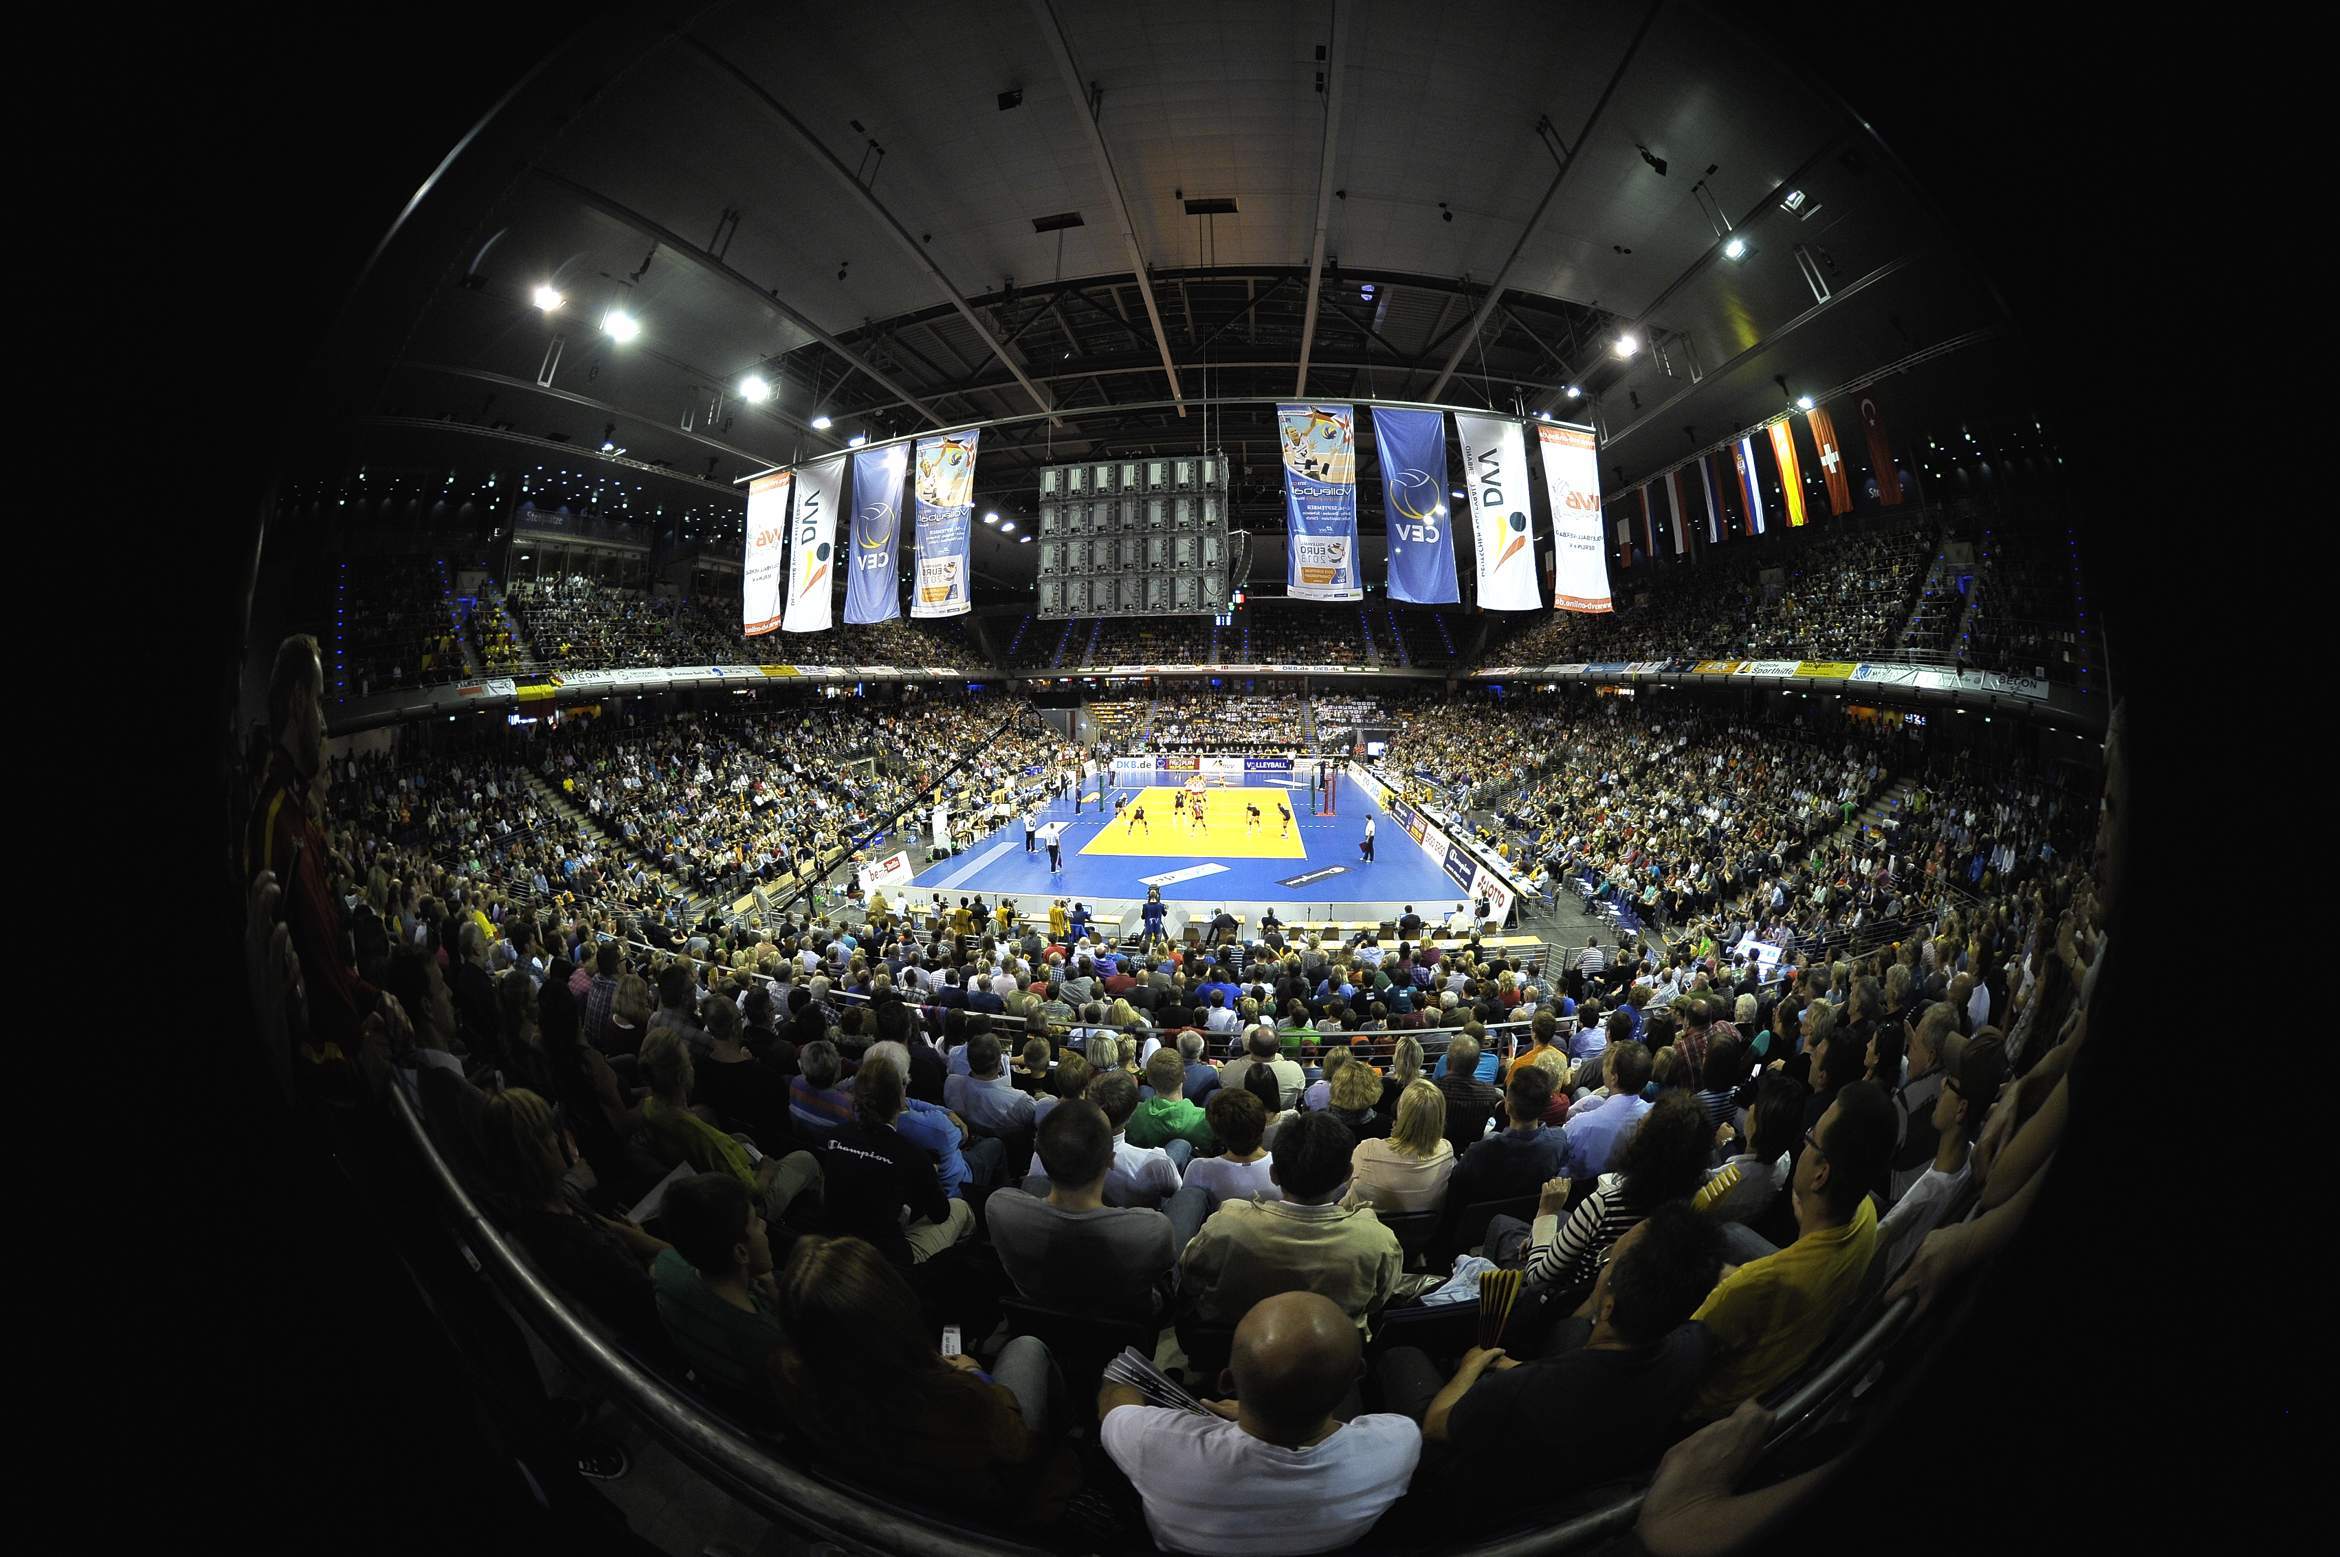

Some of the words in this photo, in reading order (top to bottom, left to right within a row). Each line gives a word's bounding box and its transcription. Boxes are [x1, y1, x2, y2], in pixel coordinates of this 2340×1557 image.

[1751, 666, 1794, 675] Sporthilfe
[1116, 760, 1152, 769] DKB.de
[1246, 761, 1287, 769] VOLLEYBALL
[1485, 880, 1505, 908] LOTTO
[827, 1139, 894, 1165] Champion
